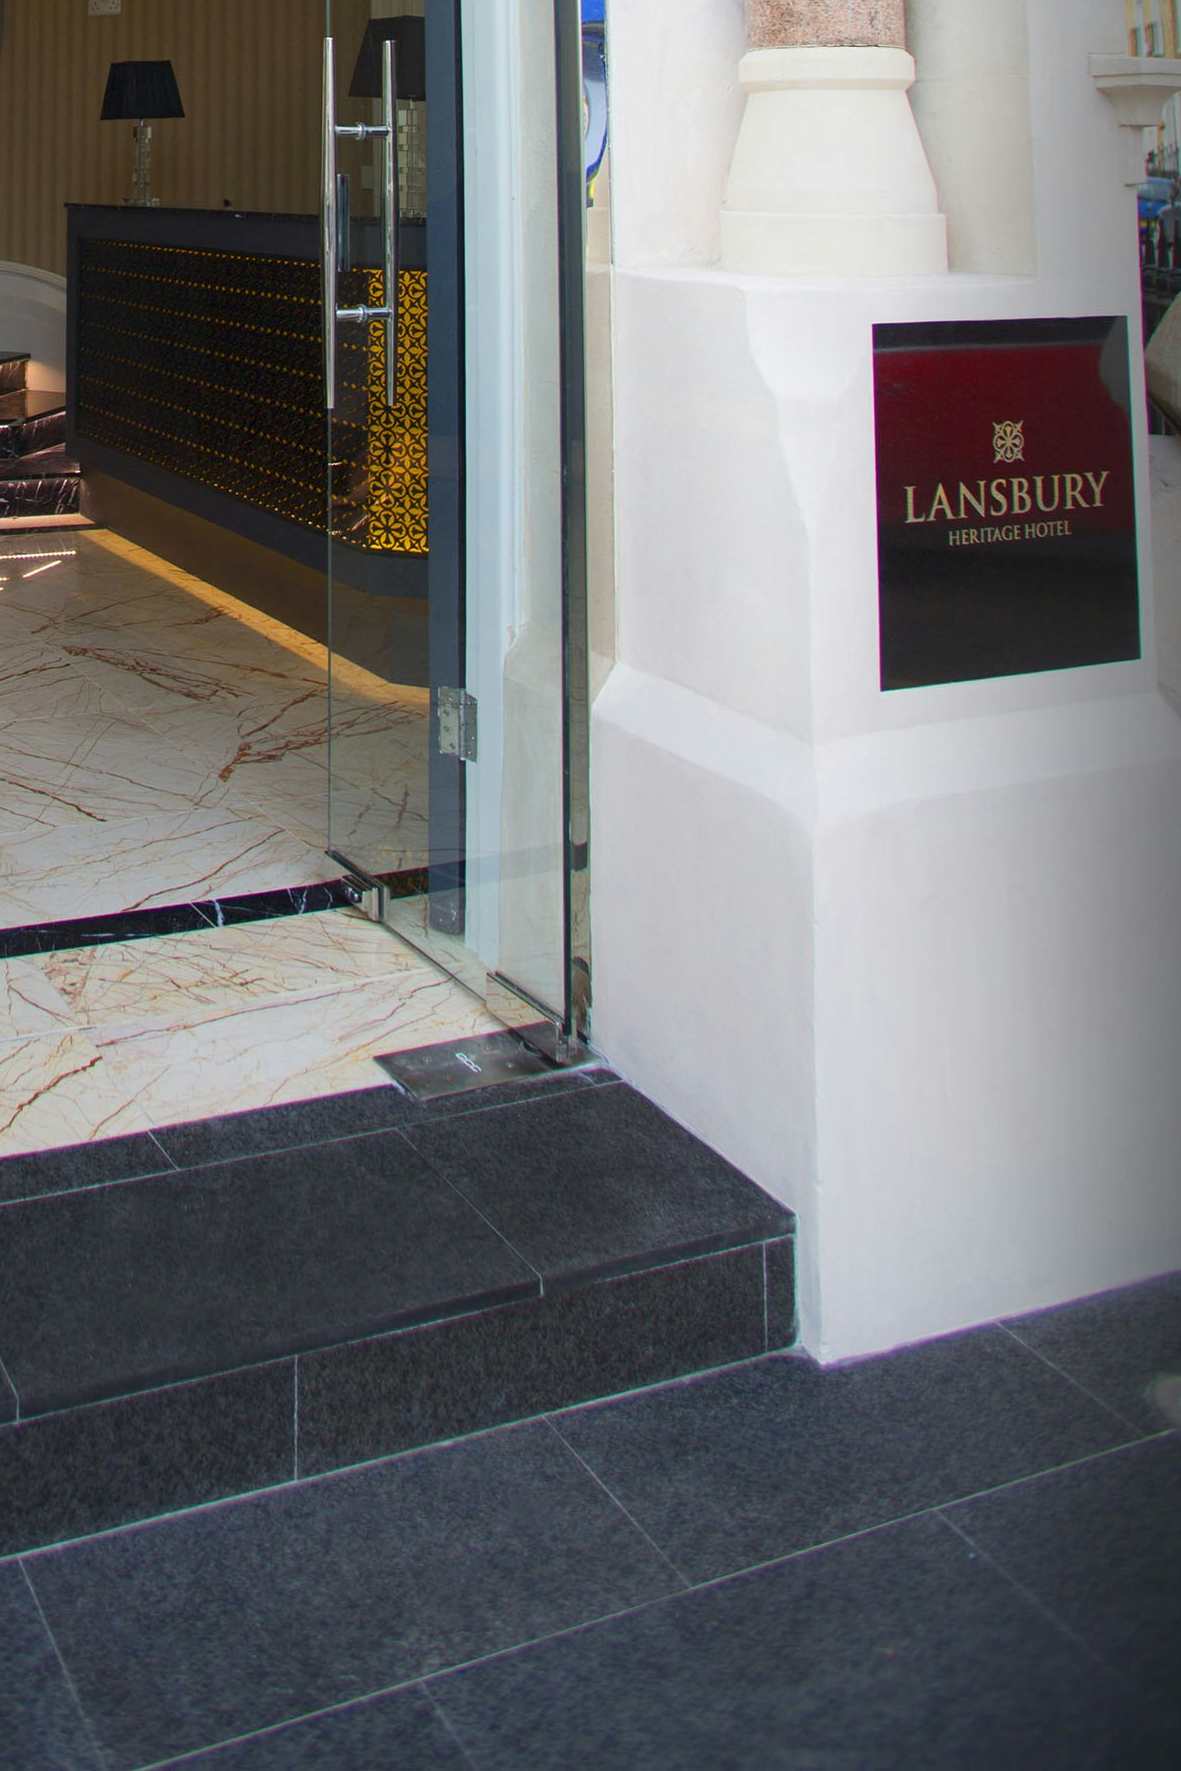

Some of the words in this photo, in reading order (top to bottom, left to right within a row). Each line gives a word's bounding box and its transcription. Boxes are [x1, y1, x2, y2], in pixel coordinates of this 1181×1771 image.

[904, 470, 1110, 524] LANSBURY
[948, 524, 1021, 546] HERITAGE
[1025, 520, 1072, 539] HOTEL
